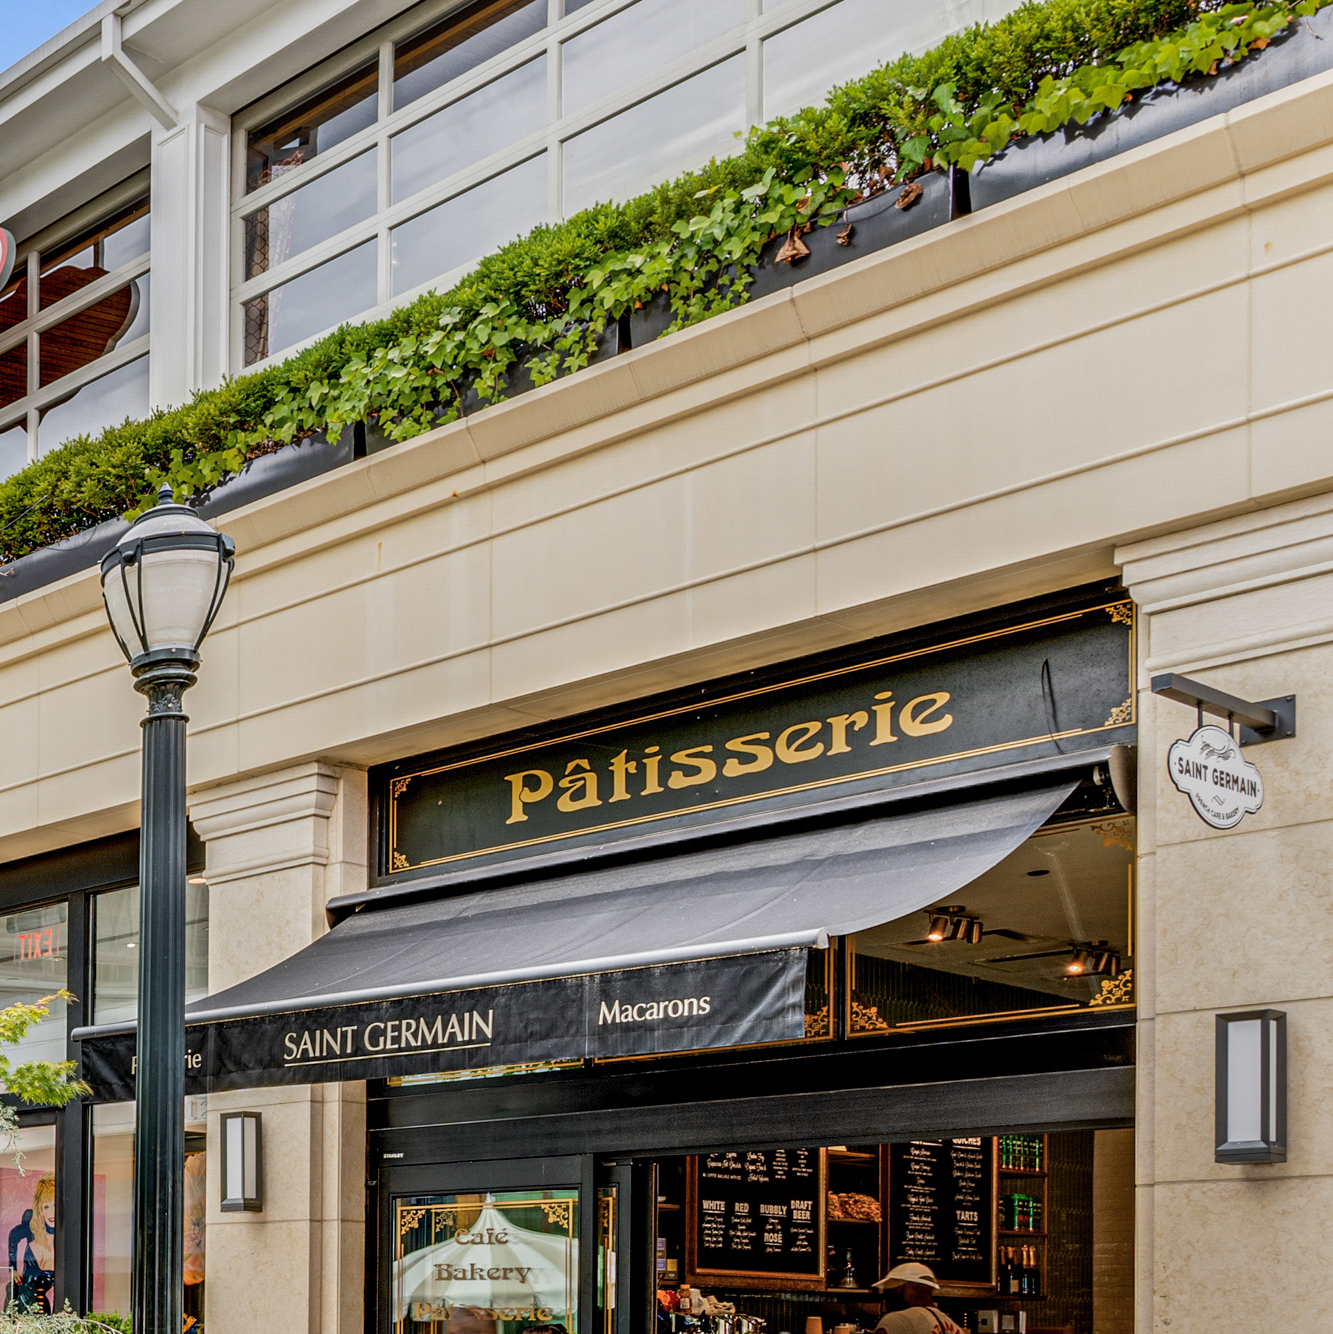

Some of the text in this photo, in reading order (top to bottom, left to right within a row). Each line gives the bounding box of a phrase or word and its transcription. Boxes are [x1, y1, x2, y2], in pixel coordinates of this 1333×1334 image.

[504, 690, 954, 826] Pâtisserie
[1178, 757, 1257, 798] SAINT GERMAIN
[598, 995, 711, 1026] Macarons
[284, 1008, 494, 1061] SAINT GERMAIN
[702, 1199, 725, 1211] WHITE
[734, 1202, 749, 1213] RED
[760, 1203, 787, 1215] BUBBLY
[790, 1200, 813, 1211] DRAFT
[793, 1210, 811, 1220] BEER
[956, 1210, 979, 1222] TARTS
[434, 1263, 531, 1284] Bakery
